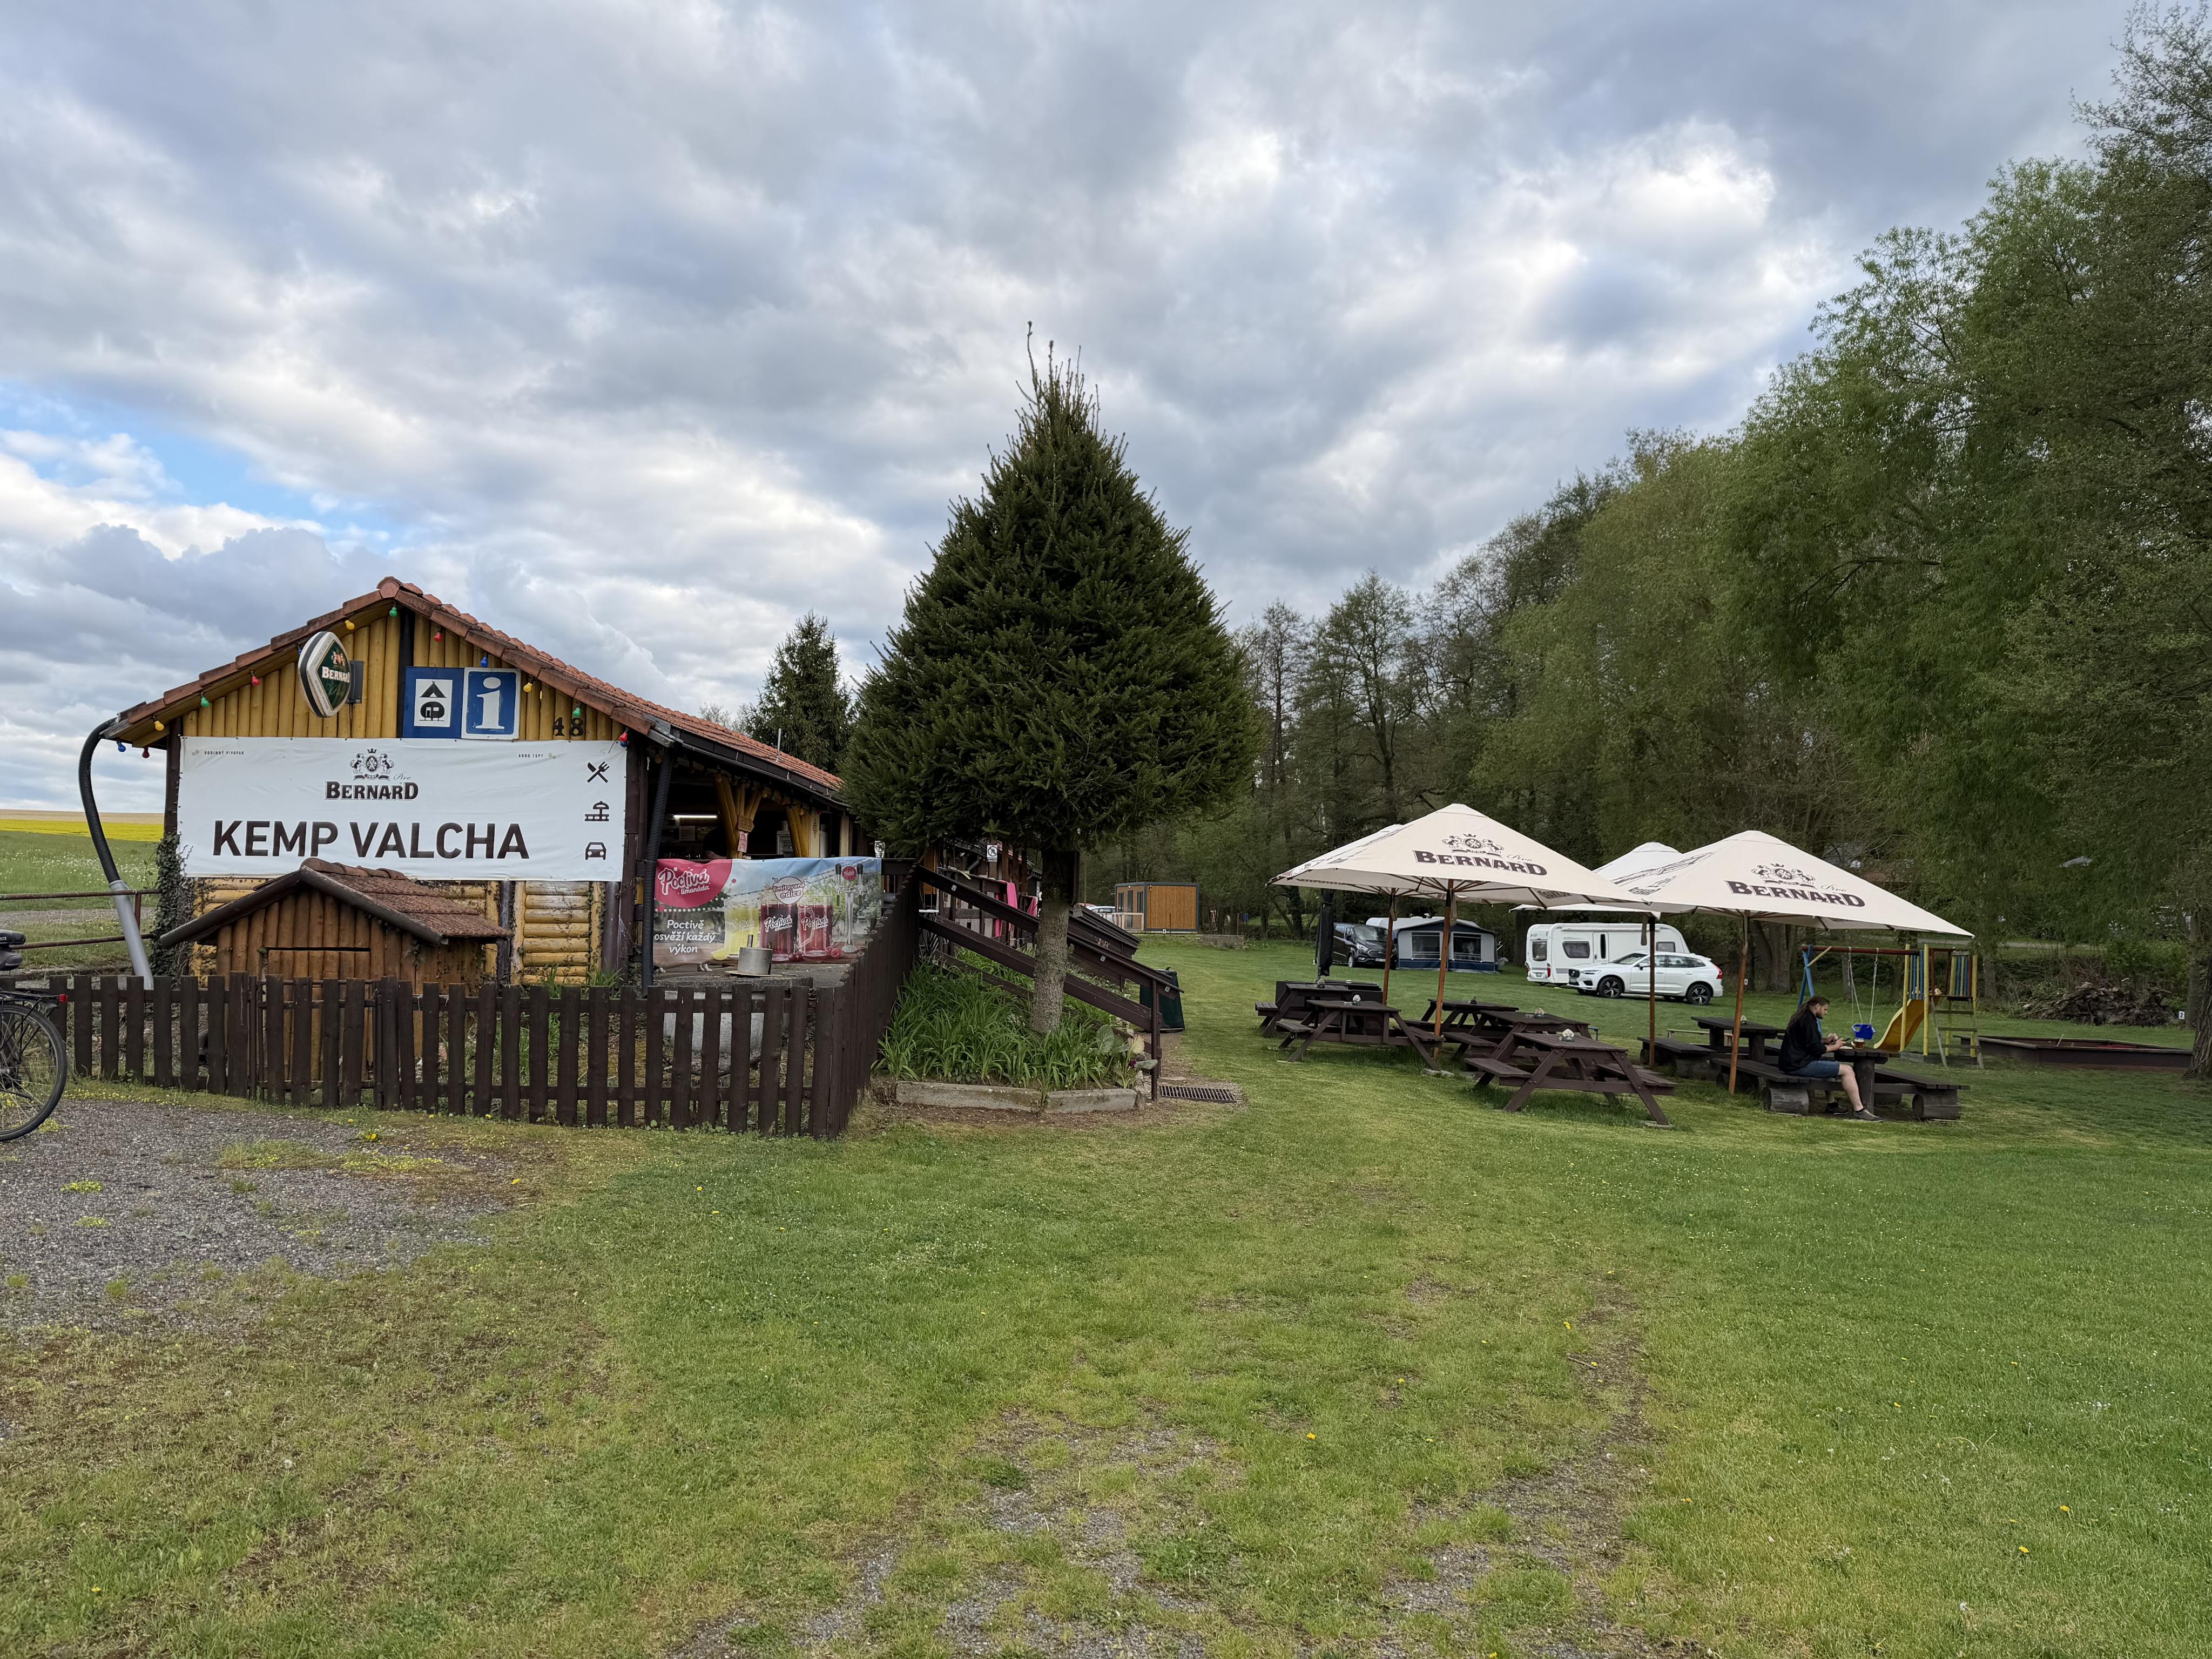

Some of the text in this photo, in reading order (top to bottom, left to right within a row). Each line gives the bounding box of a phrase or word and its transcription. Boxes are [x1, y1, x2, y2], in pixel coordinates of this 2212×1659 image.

[553, 717, 583, 737] 48
[213, 820, 530, 859] KEMP VALCHA
[658, 867, 710, 895] Poctivá
[773, 881, 805, 892] limitovaná
[680, 886, 710, 895] limonáda
[667, 919, 704, 929] Poctivě
[654, 931, 716, 943] osvěží každý
[669, 943, 698, 955] výkon
